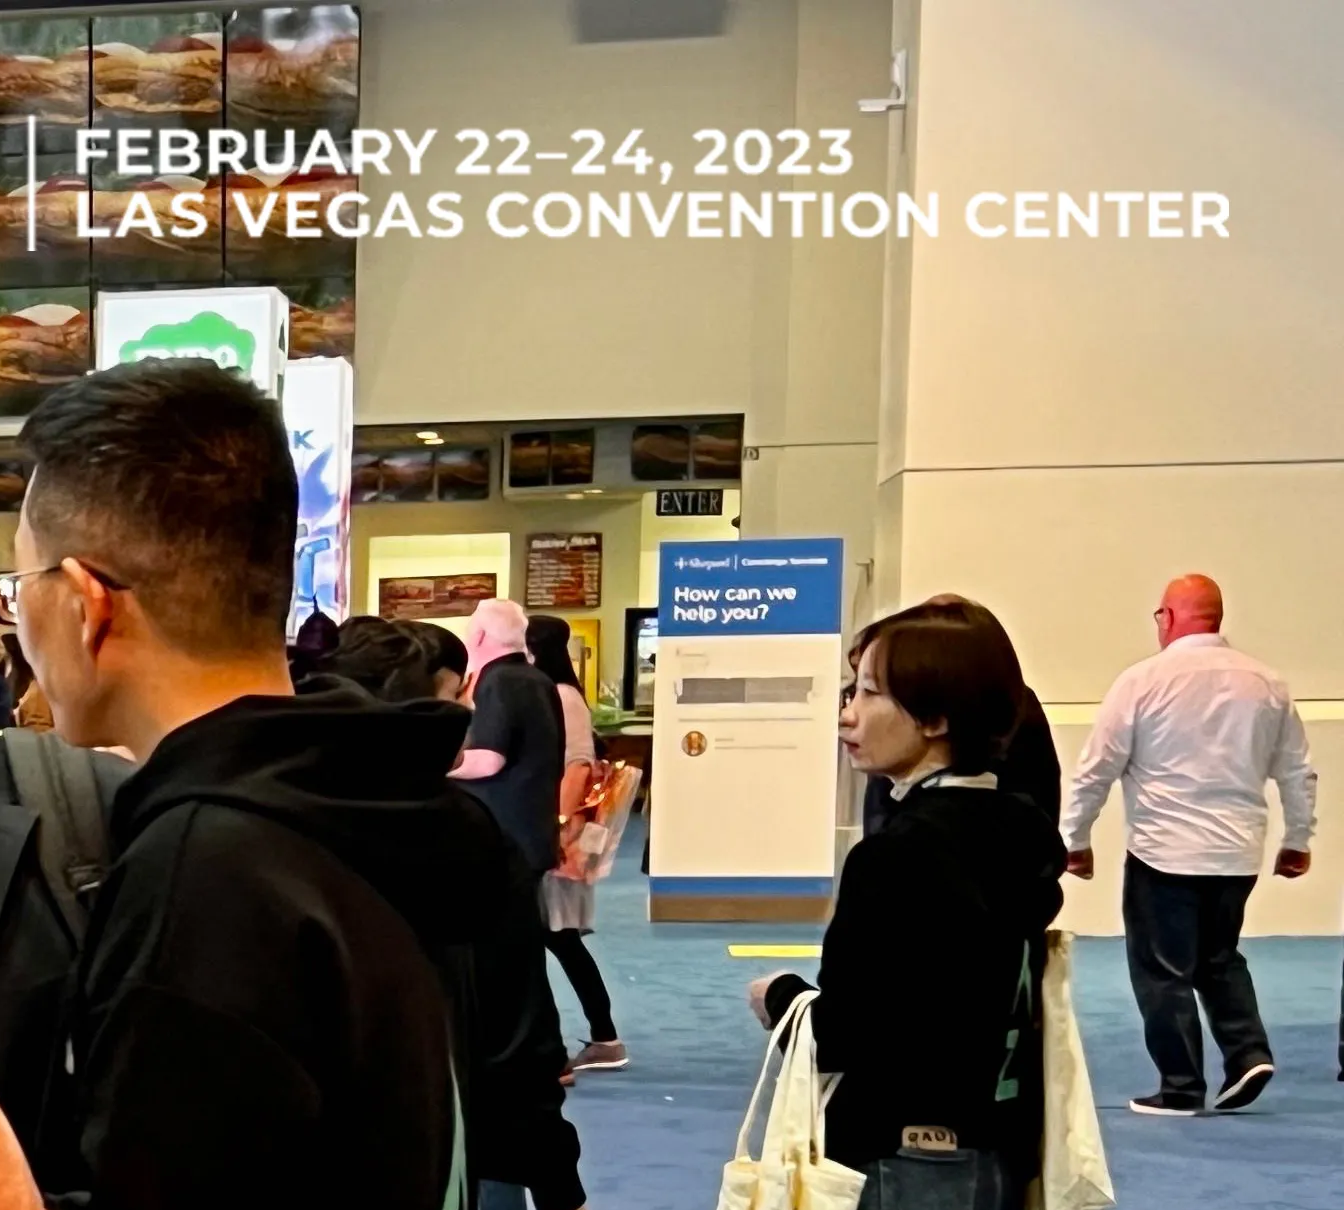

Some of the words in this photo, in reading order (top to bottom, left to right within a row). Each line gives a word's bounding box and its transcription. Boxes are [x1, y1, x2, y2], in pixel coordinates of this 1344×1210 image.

[662, 491, 721, 514] ENTER
[674, 587, 720, 602] How
[725, 588, 761, 601] can
[767, 587, 796, 601] we
[673, 605, 717, 623] help
[721, 604, 769, 624] you?
